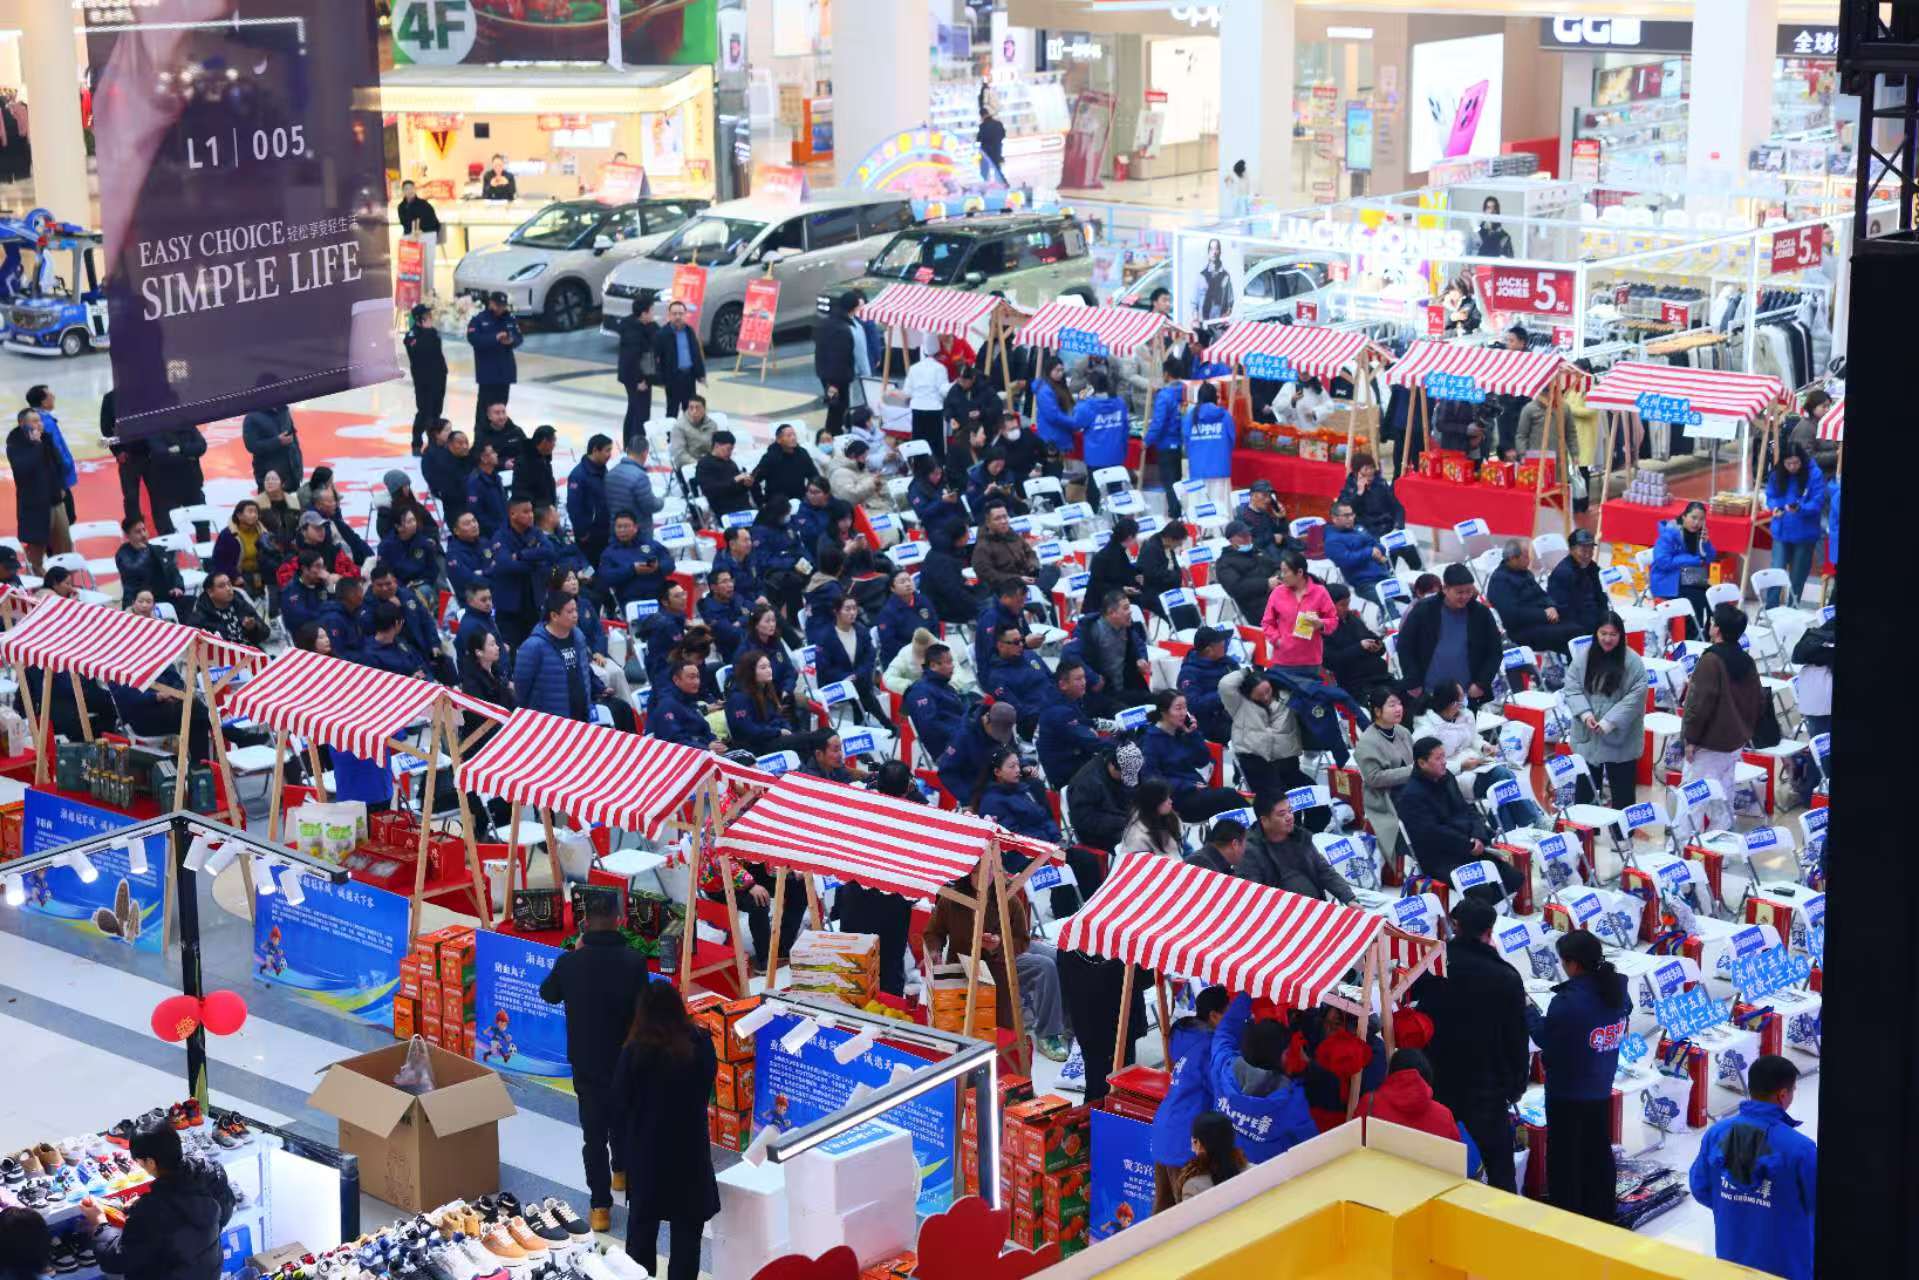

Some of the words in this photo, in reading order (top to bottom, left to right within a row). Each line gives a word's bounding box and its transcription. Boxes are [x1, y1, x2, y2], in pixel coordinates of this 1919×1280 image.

[397, 1, 466, 50] 4F
[187, 136, 220, 169] L1
[252, 125, 305, 161] 005
[138, 235, 193, 267] EASY
[199, 220, 285, 257] CHOICE
[141, 256, 280, 321] SIMPLE
[288, 240, 362, 294] LIFE
[1533, 271, 1557, 310] 5
